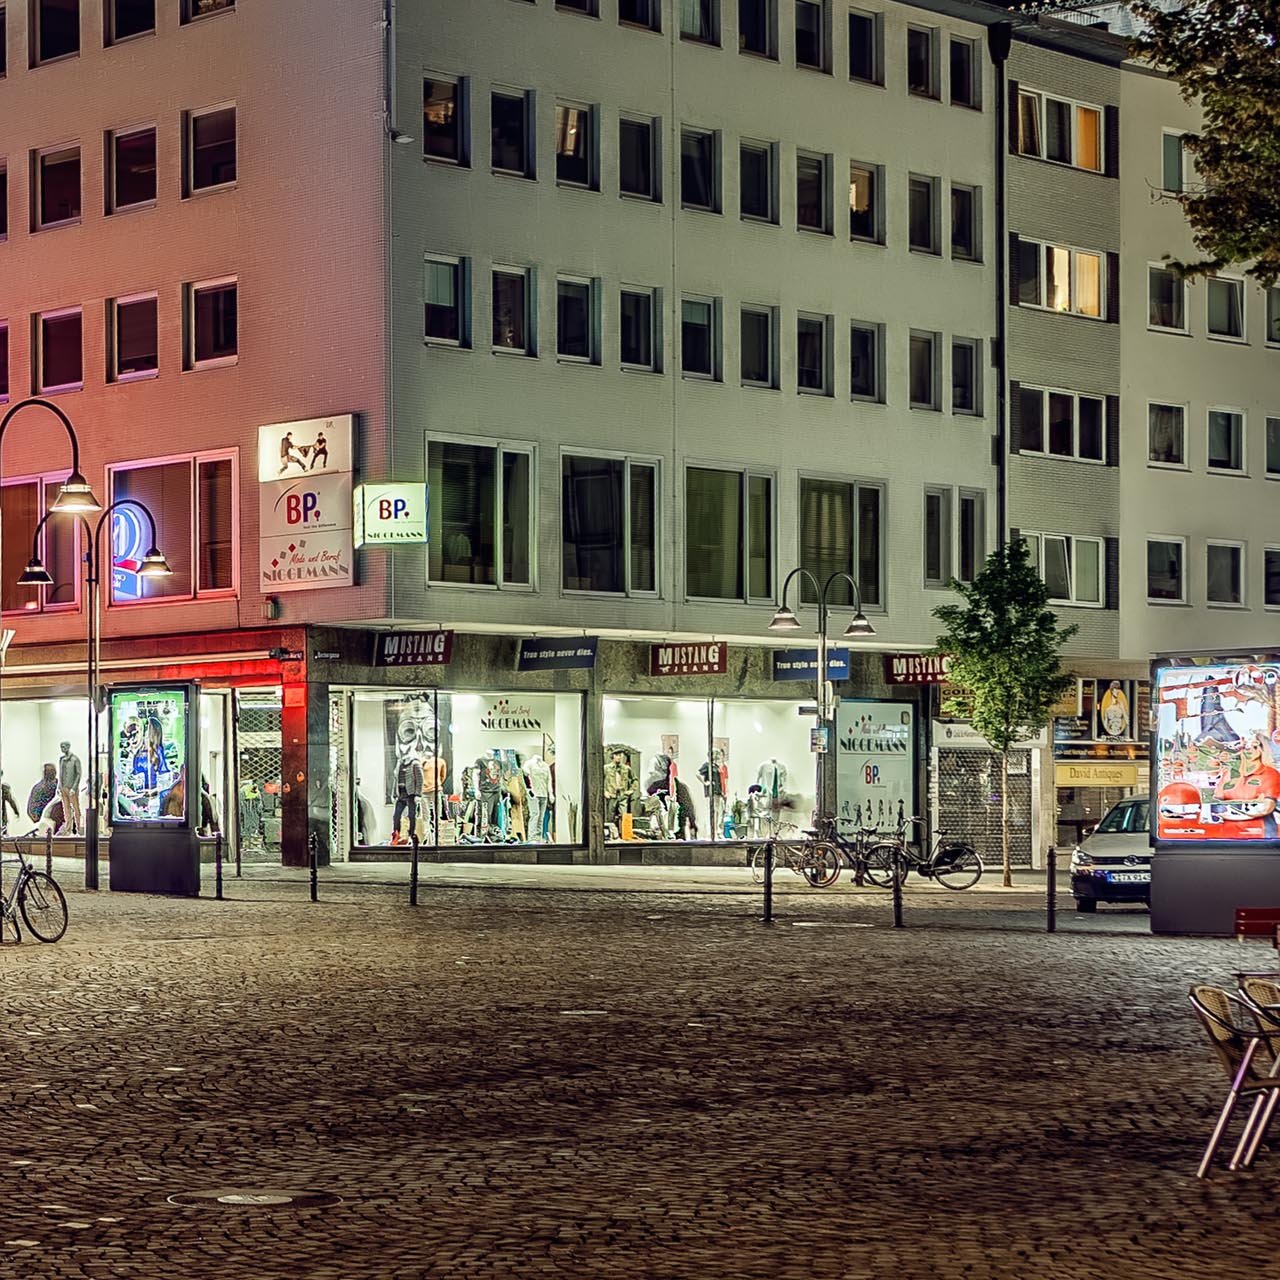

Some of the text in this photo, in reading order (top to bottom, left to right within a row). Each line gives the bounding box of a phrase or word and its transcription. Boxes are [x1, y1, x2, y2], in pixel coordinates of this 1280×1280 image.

[263, 563, 349, 581] NIGGEMANN
[384, 634, 445, 654] MUSTANG
[398, 654, 443, 663] JEANS
[523, 651, 538, 659] True
[539, 649, 555, 659] style
[556, 649, 575, 657] never
[659, 645, 719, 665] MUSTANG
[674, 664, 719, 672] JEANS
[776, 661, 791, 669] True
[792, 660, 808, 669] style
[481, 717, 541, 729] NIGGEMANN
[840, 738, 907, 752] NIGGEMANN
